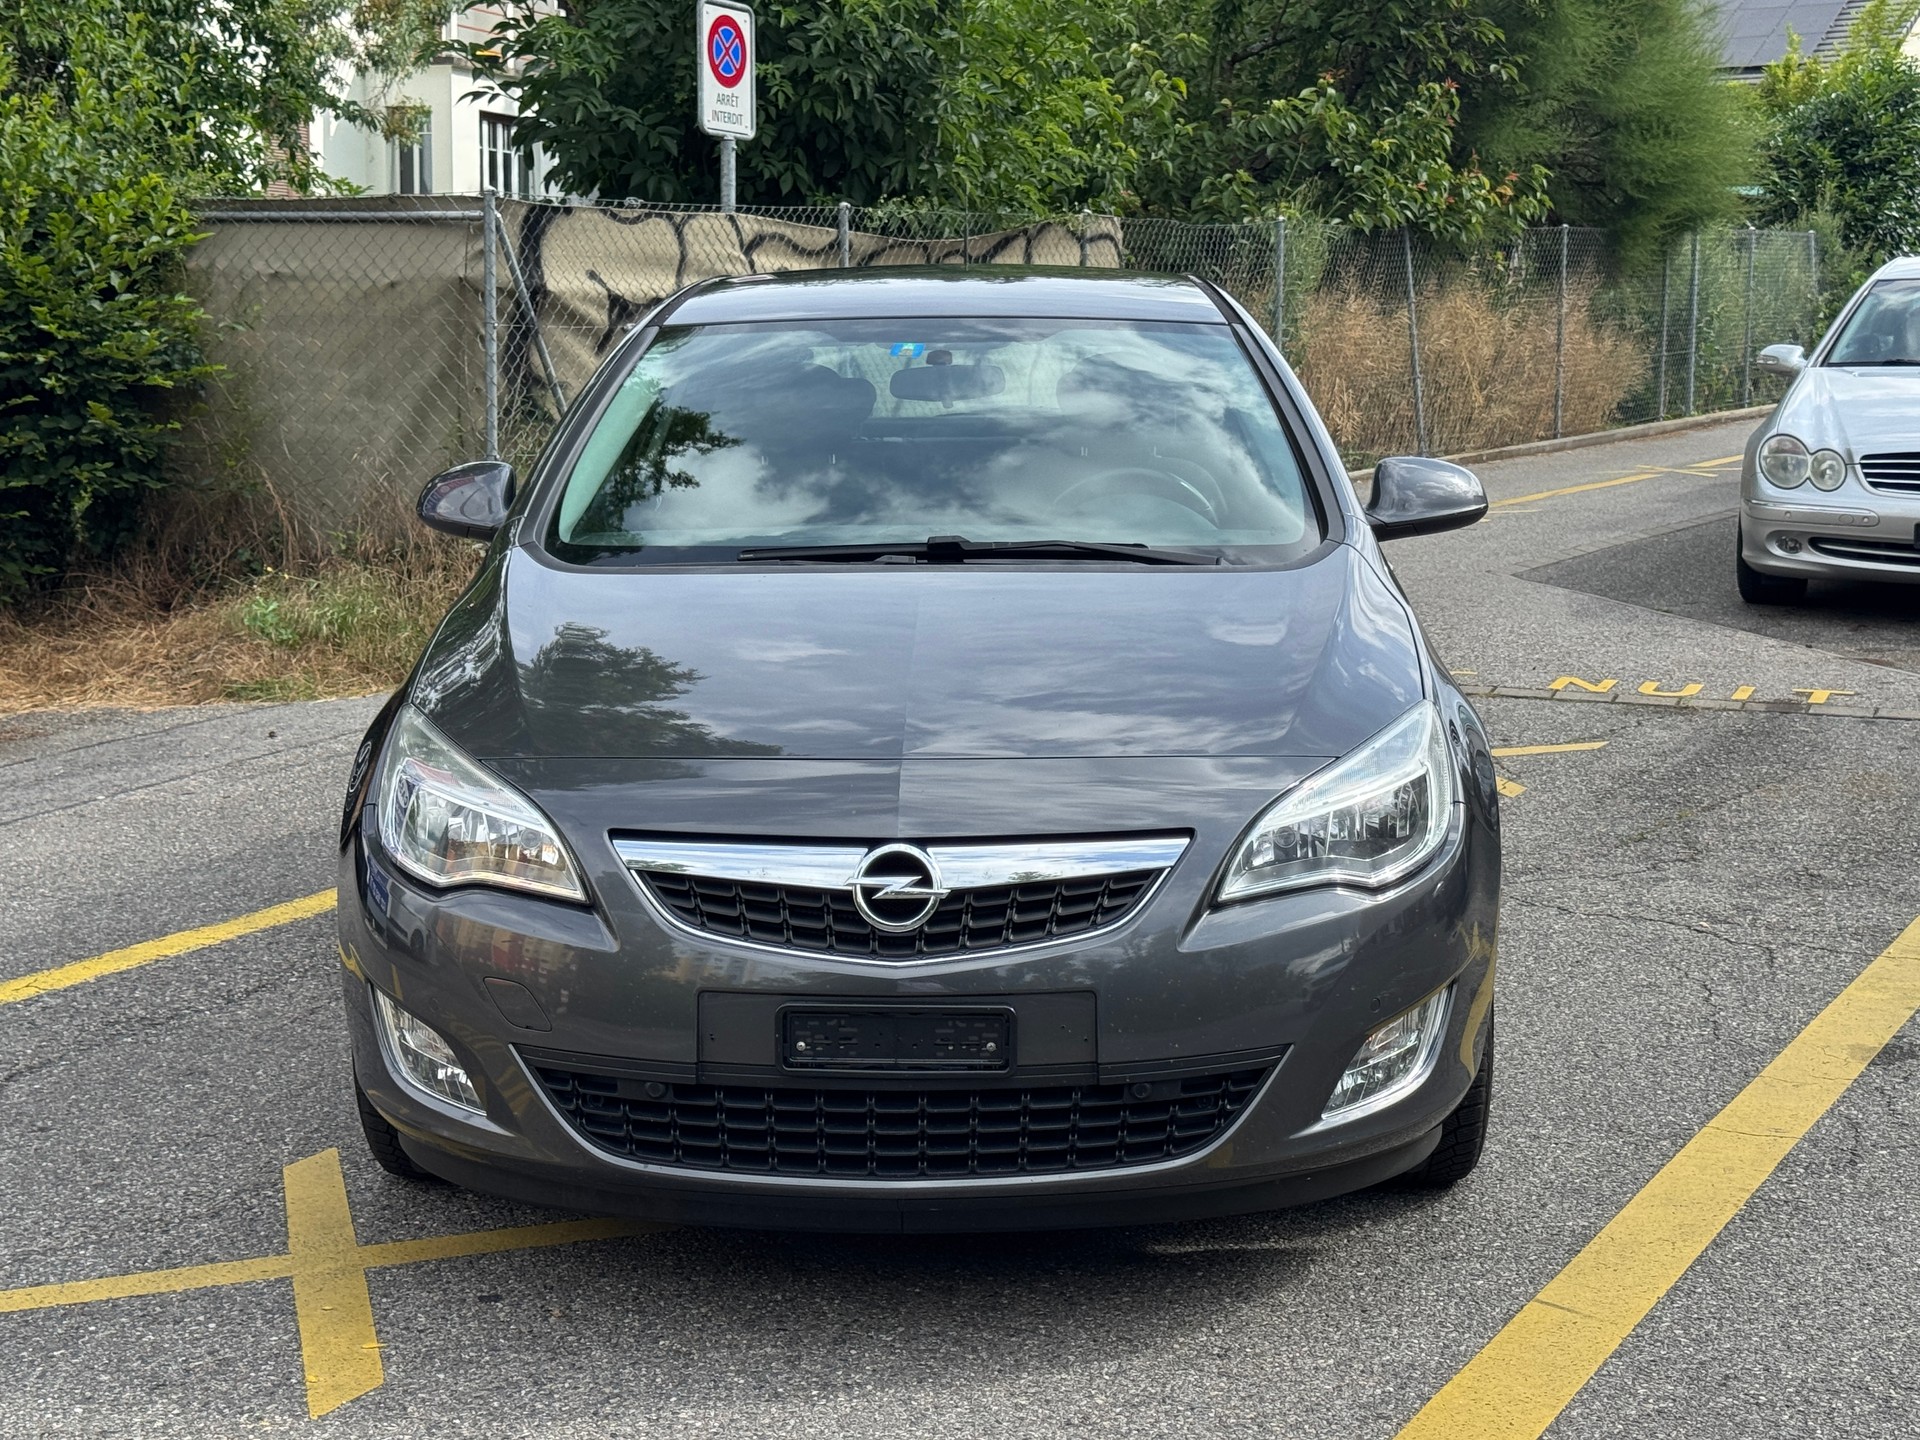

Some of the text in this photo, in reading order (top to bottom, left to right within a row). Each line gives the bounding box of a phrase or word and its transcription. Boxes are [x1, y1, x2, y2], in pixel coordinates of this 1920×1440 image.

[716, 92, 739, 108] ARRÊT
[711, 109, 744, 126] INTERDIT
[1547, 676, 1855, 704] NUIT
